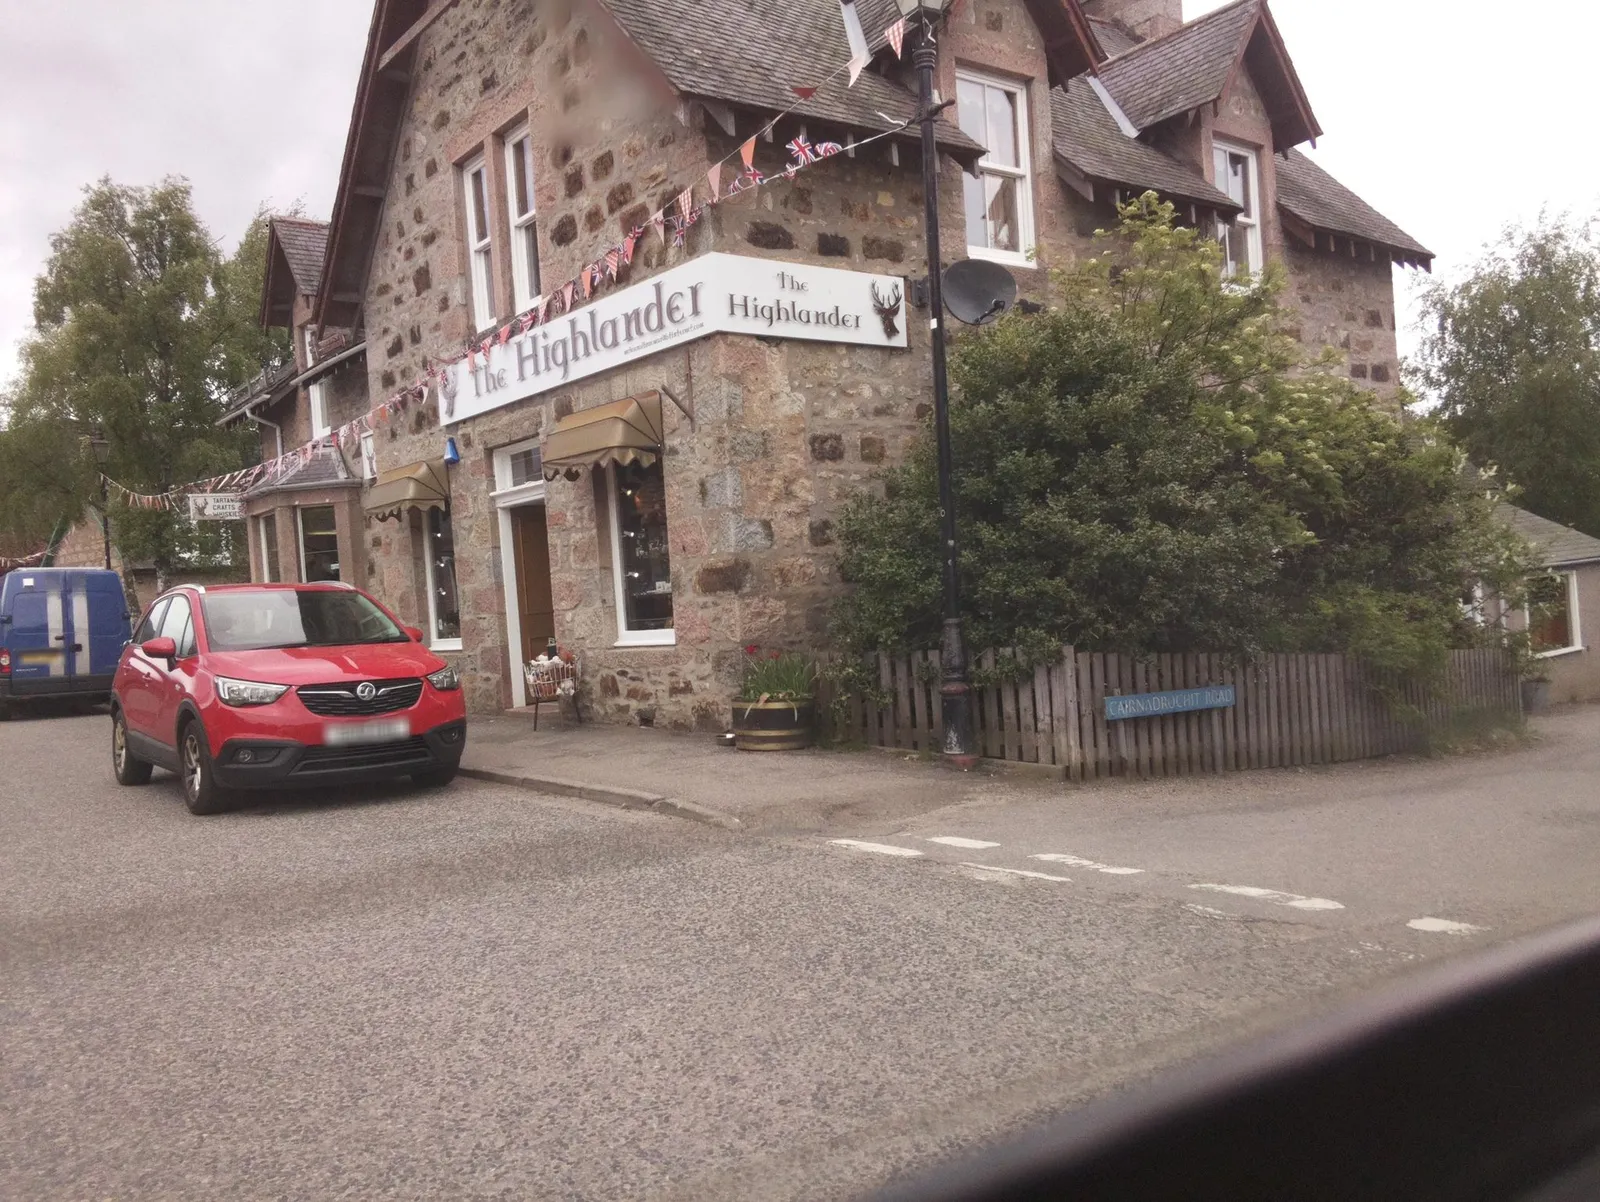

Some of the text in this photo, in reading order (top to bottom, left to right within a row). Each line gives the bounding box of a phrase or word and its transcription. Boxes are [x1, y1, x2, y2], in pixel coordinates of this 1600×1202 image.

[776, 271, 808, 291] The
[728, 293, 862, 328] Highlander
[469, 363, 508, 397] The
[515, 280, 703, 382] Highlander
[1205, 689, 1232, 705] ROAD
